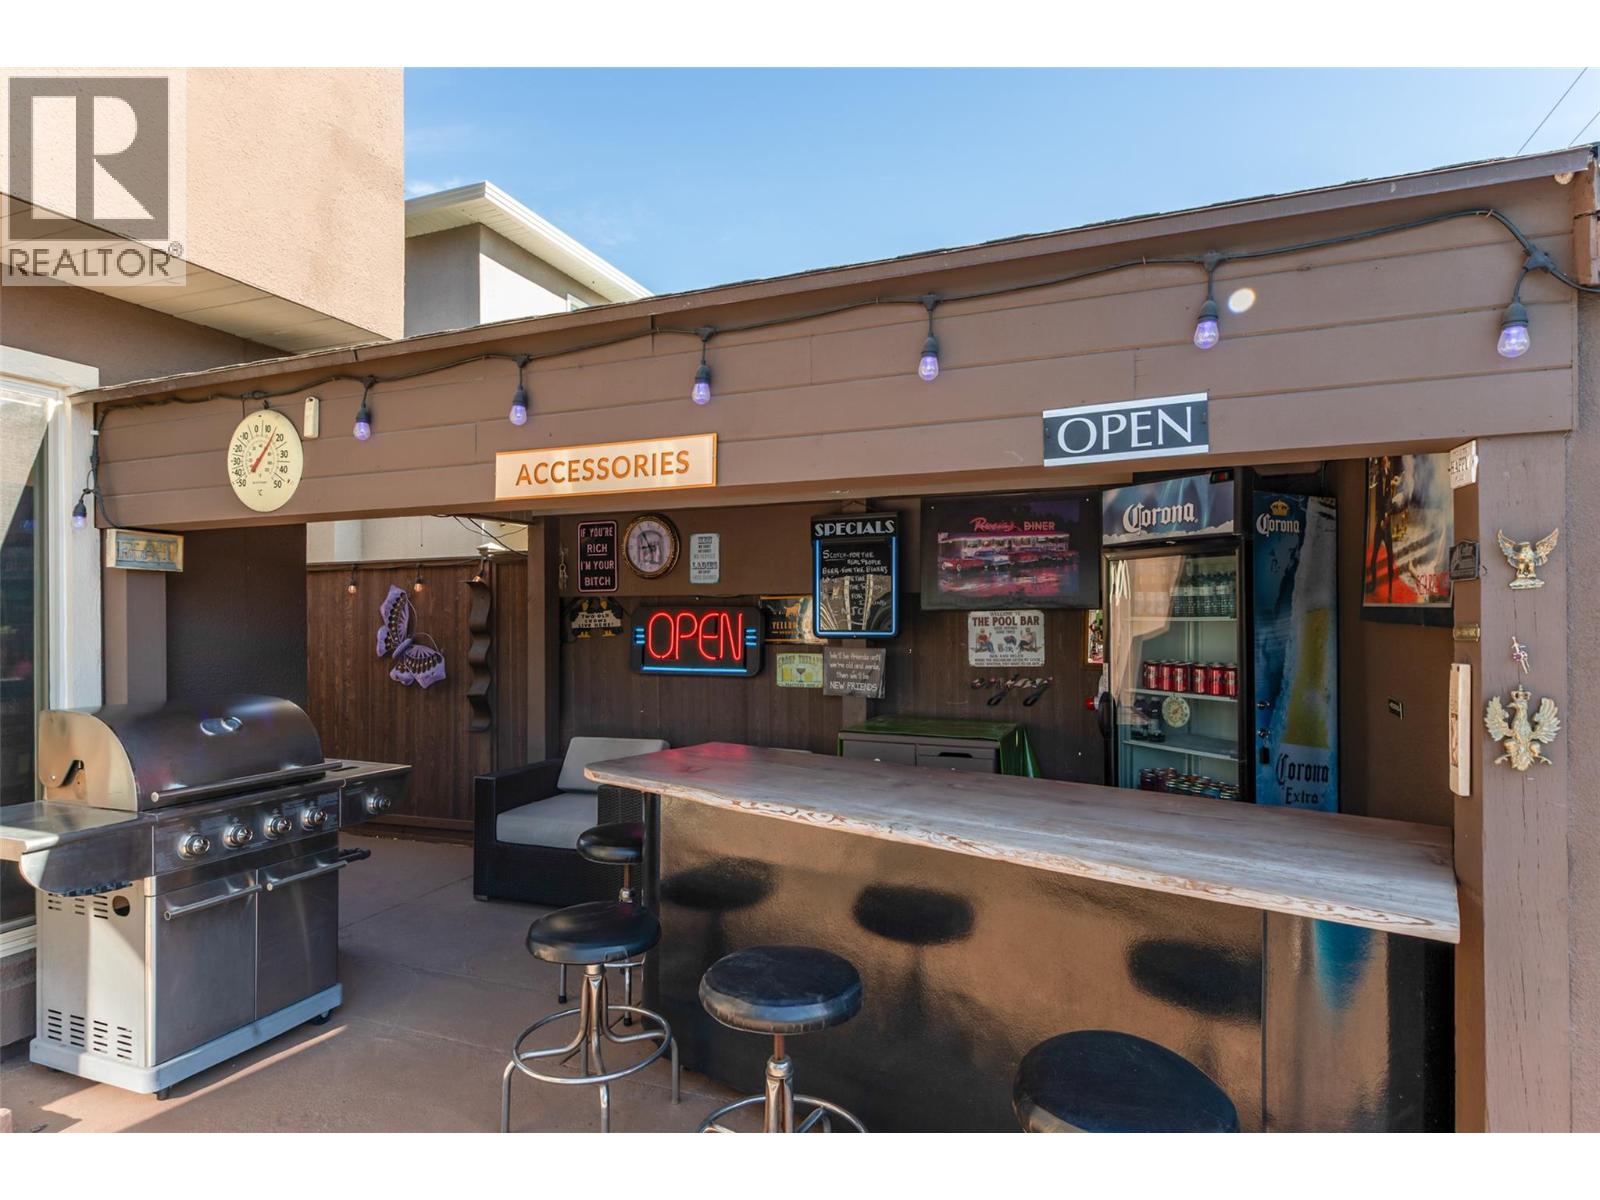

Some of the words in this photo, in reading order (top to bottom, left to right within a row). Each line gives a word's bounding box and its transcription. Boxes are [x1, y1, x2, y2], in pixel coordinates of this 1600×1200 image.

[1058, 406, 1192, 453] OPEN
[276, 434, 284, 442] 20
[280, 450, 288, 458] 30
[280, 465, 288, 473] 40
[515, 450, 690, 486] ACCESSORIES
[1122, 501, 1199, 534] Corona
[814, 519, 895, 537] SPECIALS
[1024, 520, 1056, 531] DINER
[1255, 512, 1300, 536] Corona
[580, 528, 586, 538] IF
[590, 527, 613, 538] YOU'RE
[587, 544, 608, 554] RICH
[580, 561, 591, 571] I'M
[593, 560, 615, 570] YOUR
[584, 576, 611, 587] BITCH
[972, 617, 990, 627] THE
[992, 616, 1018, 626] POOL
[1020, 616, 1040, 626] BAR
[648, 611, 742, 660] OPEN
[830, 680, 845, 690] NEW
[846, 681, 878, 691] FRIENDS
[1275, 752, 1329, 786] Corona
[1285, 786, 1319, 805] Extra
